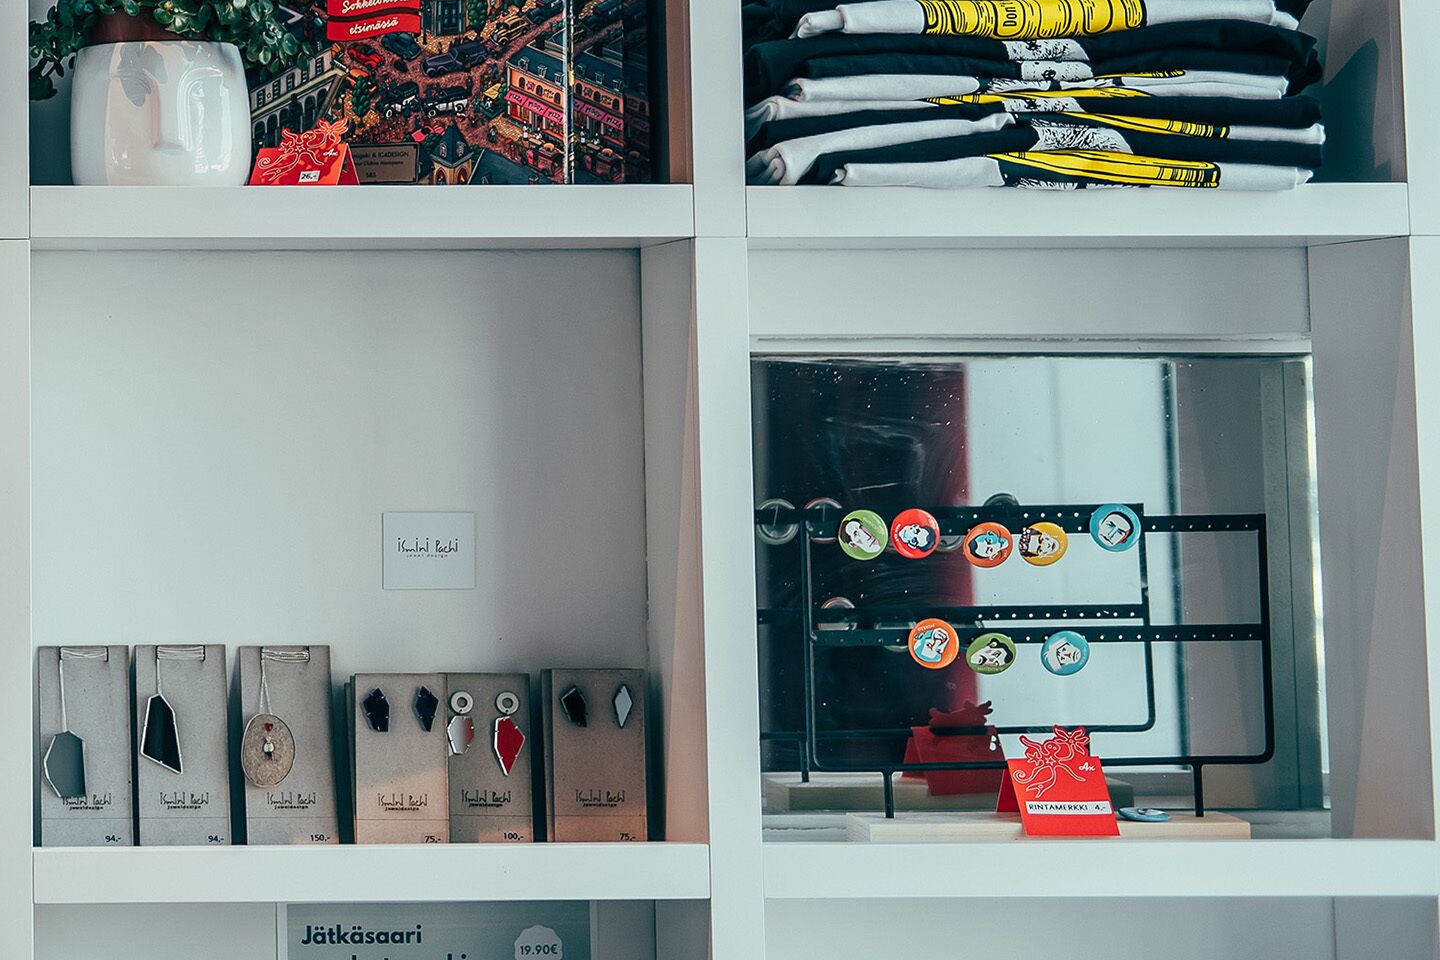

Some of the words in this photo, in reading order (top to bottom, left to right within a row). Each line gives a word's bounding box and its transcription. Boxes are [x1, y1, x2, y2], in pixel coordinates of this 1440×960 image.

[349, 16, 398, 36] etsimässä
[1028, 803, 1088, 811] RINTAMERKKI
[301, 924, 423, 945] Jätkäsaari
[519, 943, 558, 956] 19.90€
